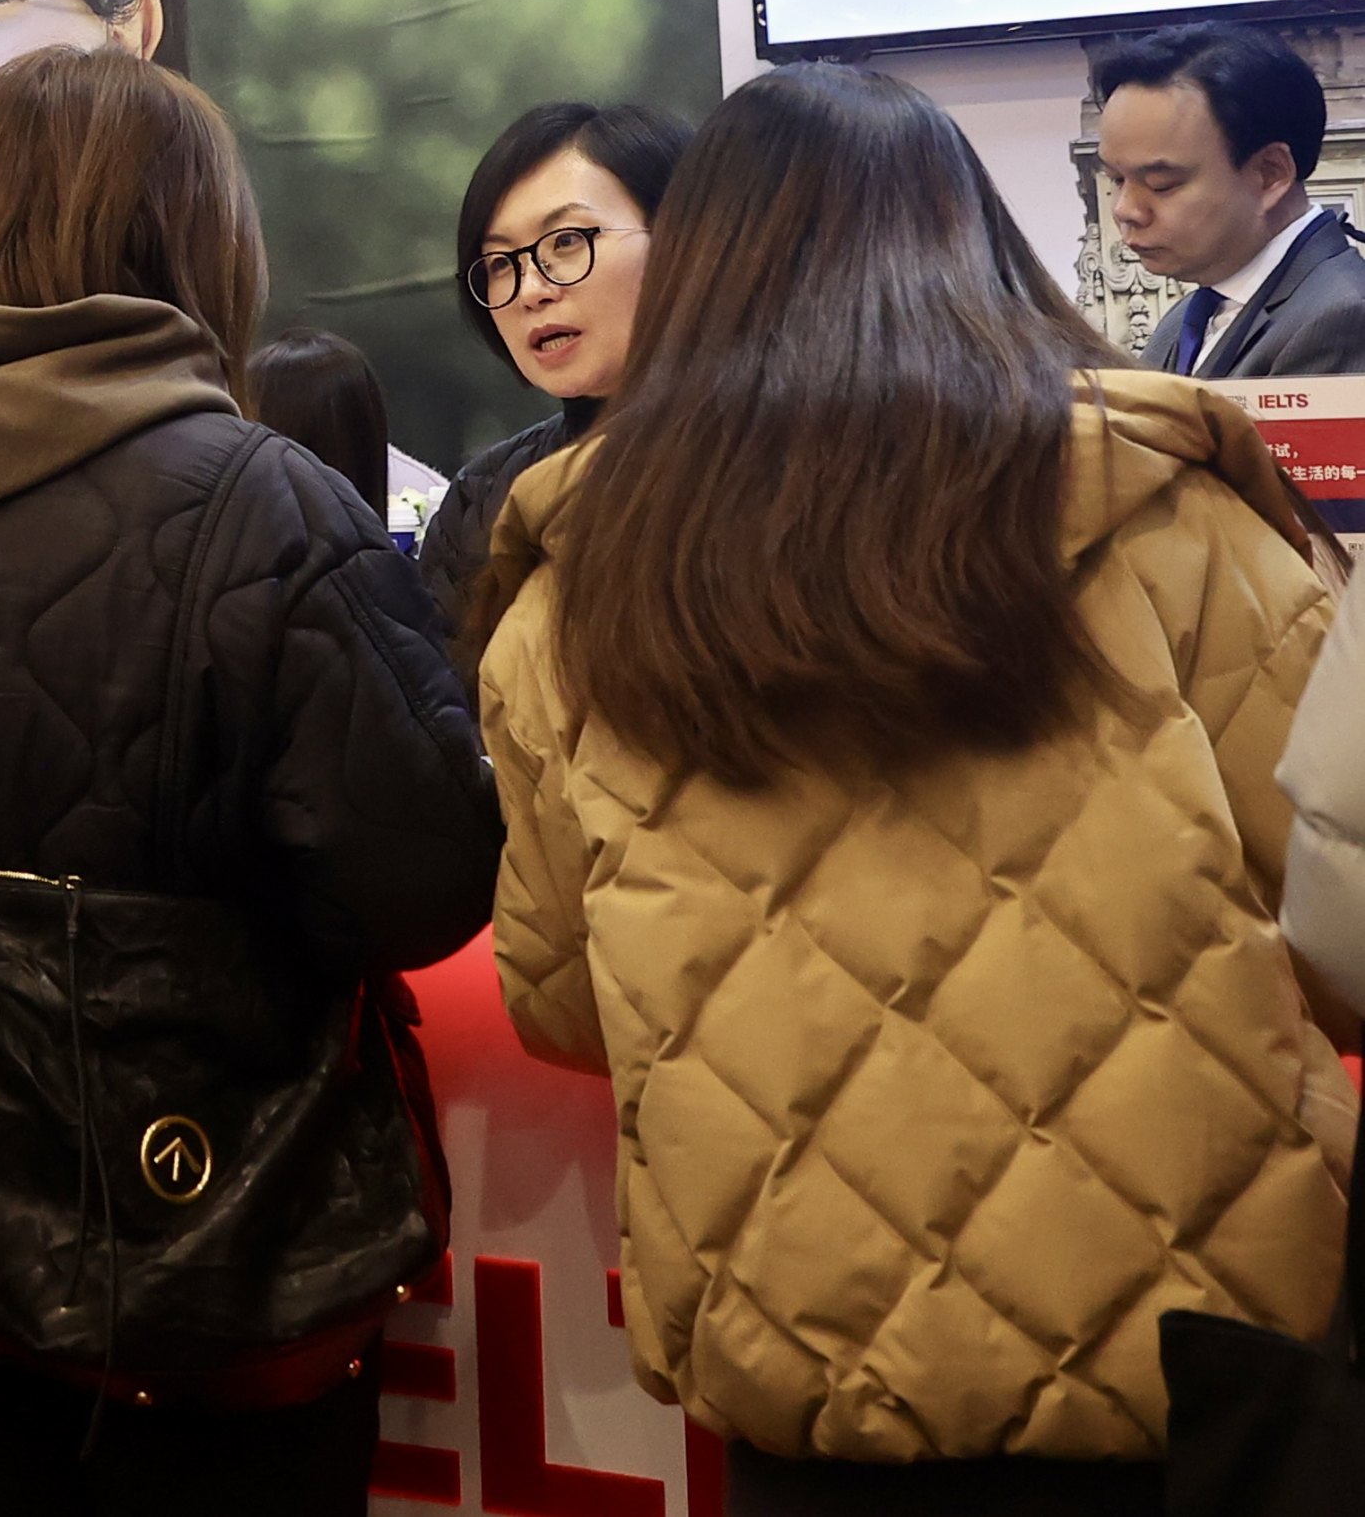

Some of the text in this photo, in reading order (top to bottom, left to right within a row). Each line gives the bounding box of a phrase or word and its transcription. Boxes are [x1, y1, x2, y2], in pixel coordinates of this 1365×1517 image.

[1258, 393, 1309, 409] IELTS
[1282, 465, 1365, 481] 生活的每一
